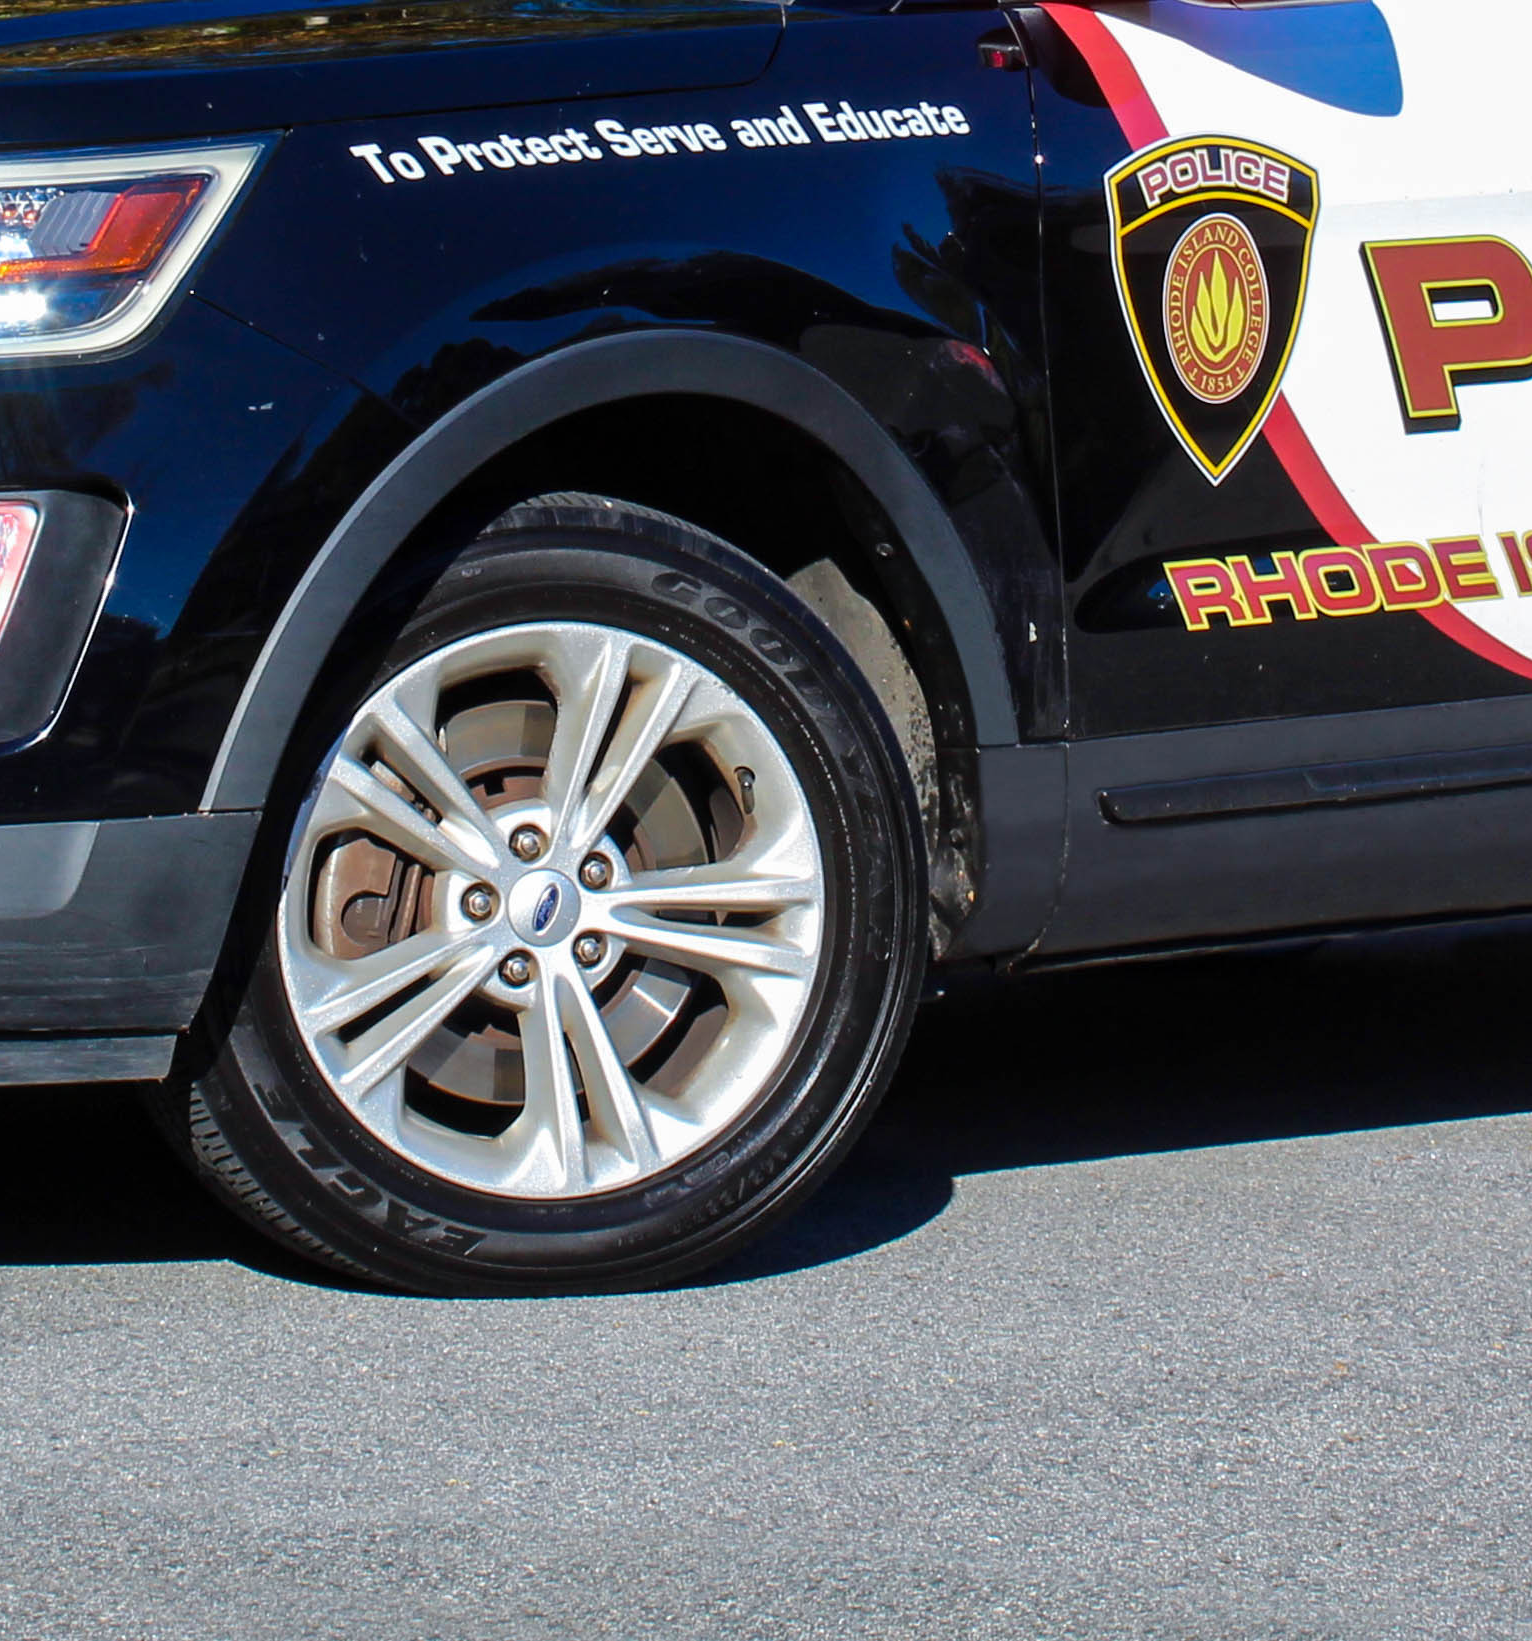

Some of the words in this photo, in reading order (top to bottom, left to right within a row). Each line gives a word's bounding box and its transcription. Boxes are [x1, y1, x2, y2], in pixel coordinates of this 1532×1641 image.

[349, 142, 426, 184] To
[417, 128, 602, 175] Protect
[594, 119, 728, 157] Serve
[730, 107, 806, 148] and
[802, 101, 971, 142] Educate
[1138, 149, 1291, 209] POLICE
[1177, 224, 1240, 271] ISLAND
[1170, 273, 1194, 368] RHODE
[1237, 246, 1262, 365] COLLEGE
[1200, 373, 1234, 393] 1854
[1162, 535, 1503, 631] RHODE
[253, 1082, 487, 1256] EAGLE
